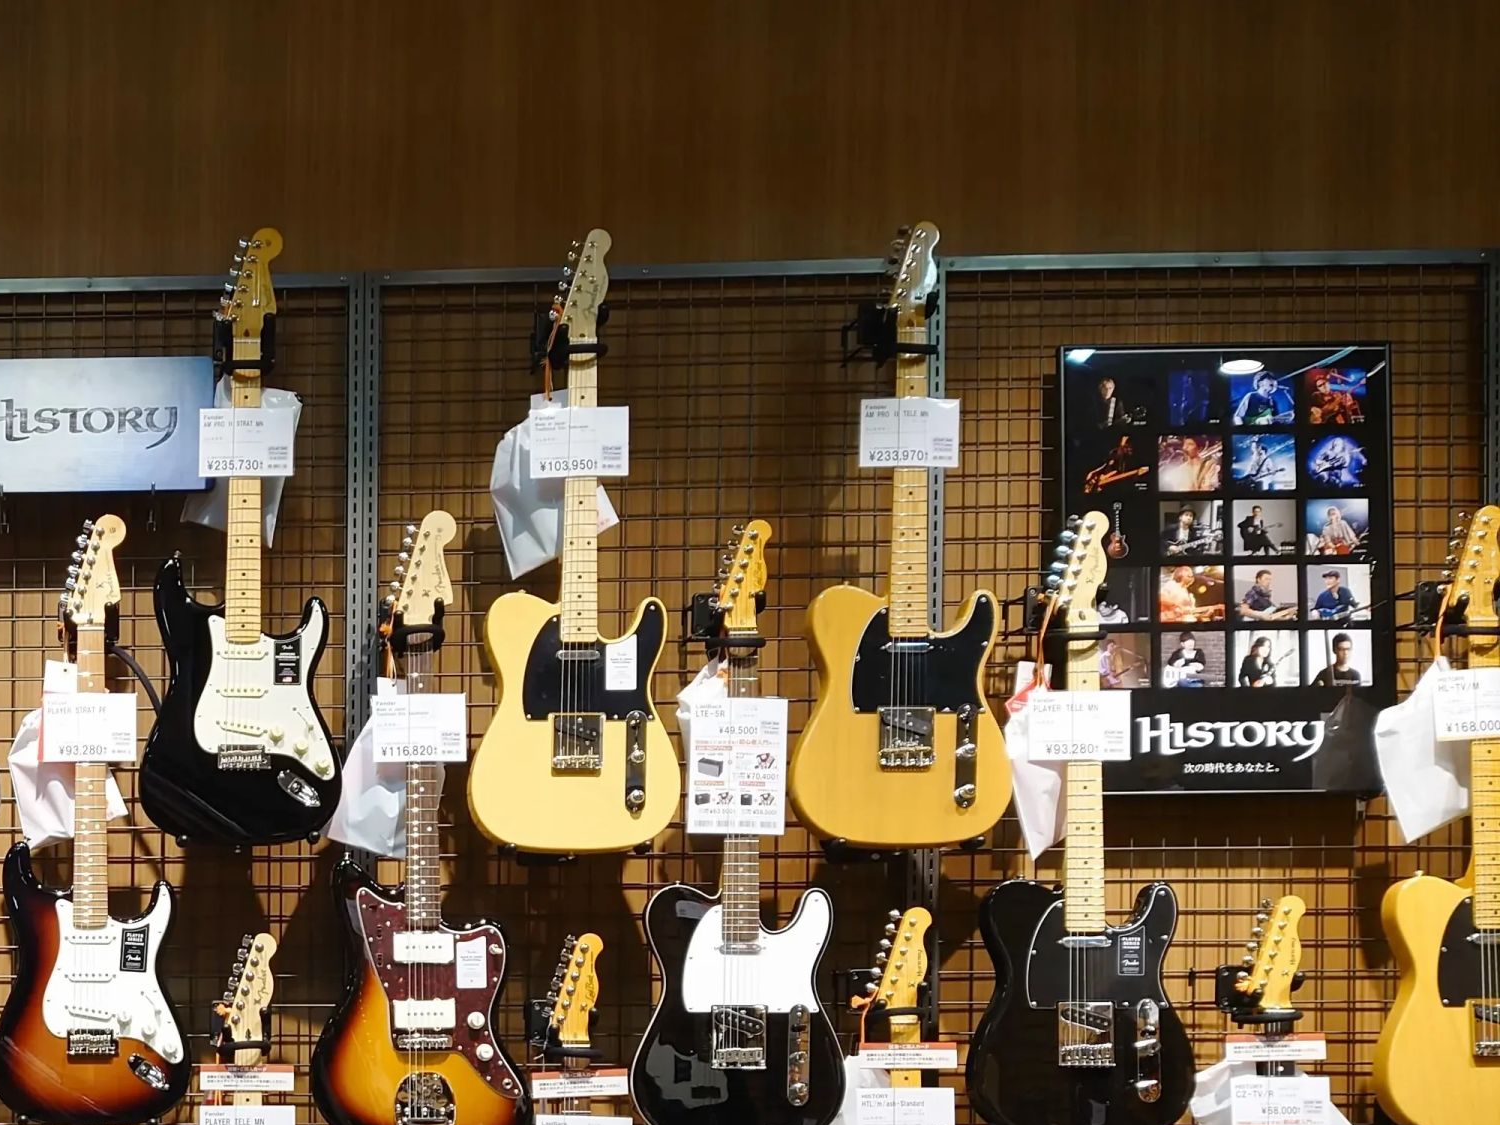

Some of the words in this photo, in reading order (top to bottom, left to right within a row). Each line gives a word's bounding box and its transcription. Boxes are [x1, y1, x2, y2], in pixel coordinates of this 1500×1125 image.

[869, 450, 925, 462] ¥233,970
[206, 459, 260, 471] ¥235,730
[539, 460, 595, 472] ¥103,950
[695, 710, 725, 718] LTE-5R
[719, 726, 754, 735] ¥49,500
[1135, 713, 1326, 762] HISTORY
[58, 745, 104, 757] ¥93,280
[381, 745, 434, 758] ¥116,820
[1045, 743, 1096, 755] ¥93,280
[1183, 762, 1281, 774] 次の時代をあなたと。
[205, 1118, 231, 1125] PLAYER
[234, 1118, 251, 1125] TELE
